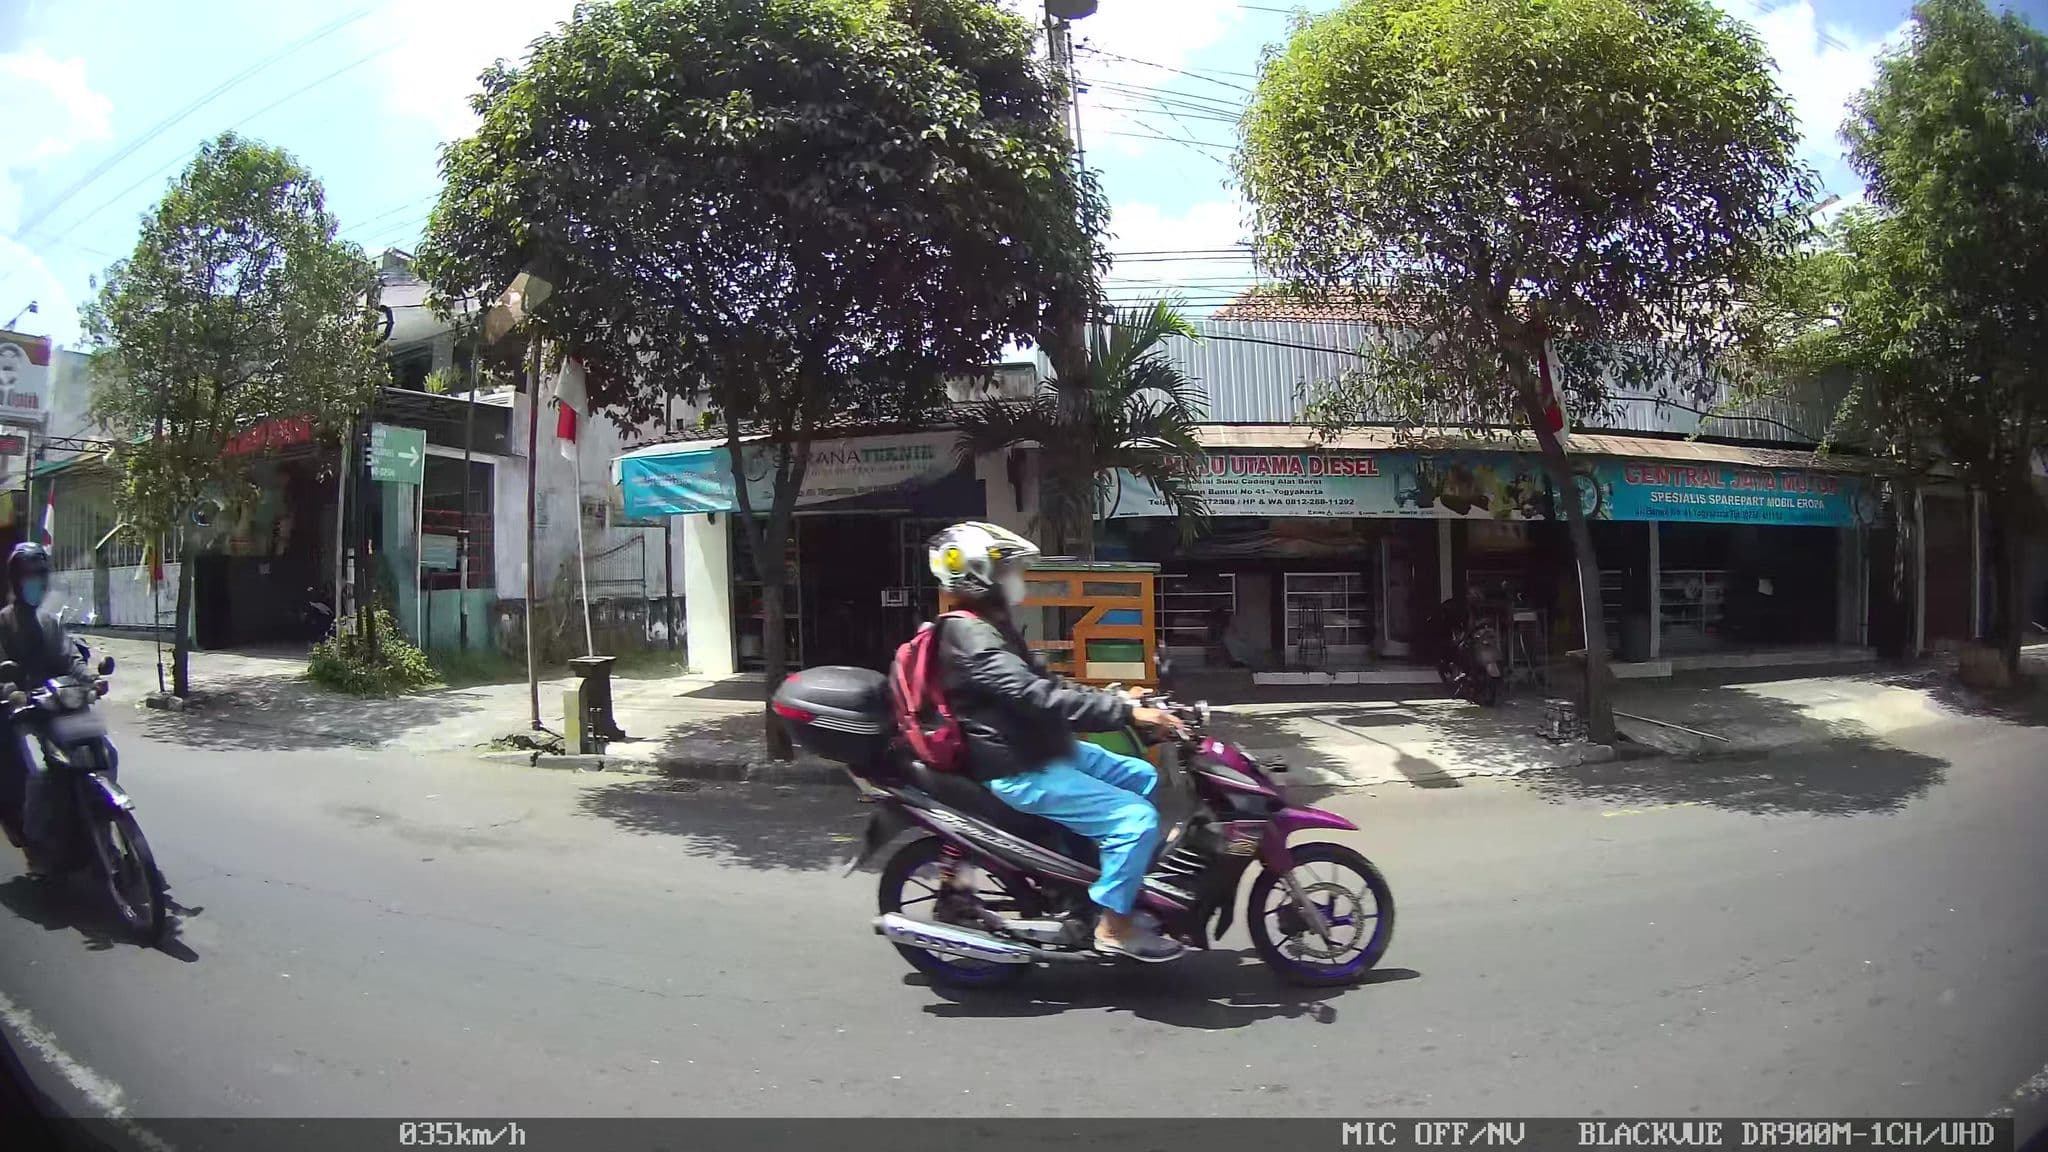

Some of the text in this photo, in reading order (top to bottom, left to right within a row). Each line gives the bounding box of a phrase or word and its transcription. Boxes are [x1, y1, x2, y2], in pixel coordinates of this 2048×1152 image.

[1231, 455, 1304, 476] UTAMA
[1308, 455, 1379, 477] DIESEL
[1241, 477, 1276, 488] Cadang
[1624, 464, 1726, 489] CENTRAL
[1730, 469, 1776, 491] JAYA
[1240, 487, 1254, 496] No
[1273, 487, 1324, 498] Yogyakarta
[1243, 498, 1257, 507] HP
[1267, 498, 1284, 507] WA
[1650, 491, 1707, 505] SPESIALIS
[1708, 493, 1765, 508] SPAREPART
[1766, 496, 1795, 509] MOBIL
